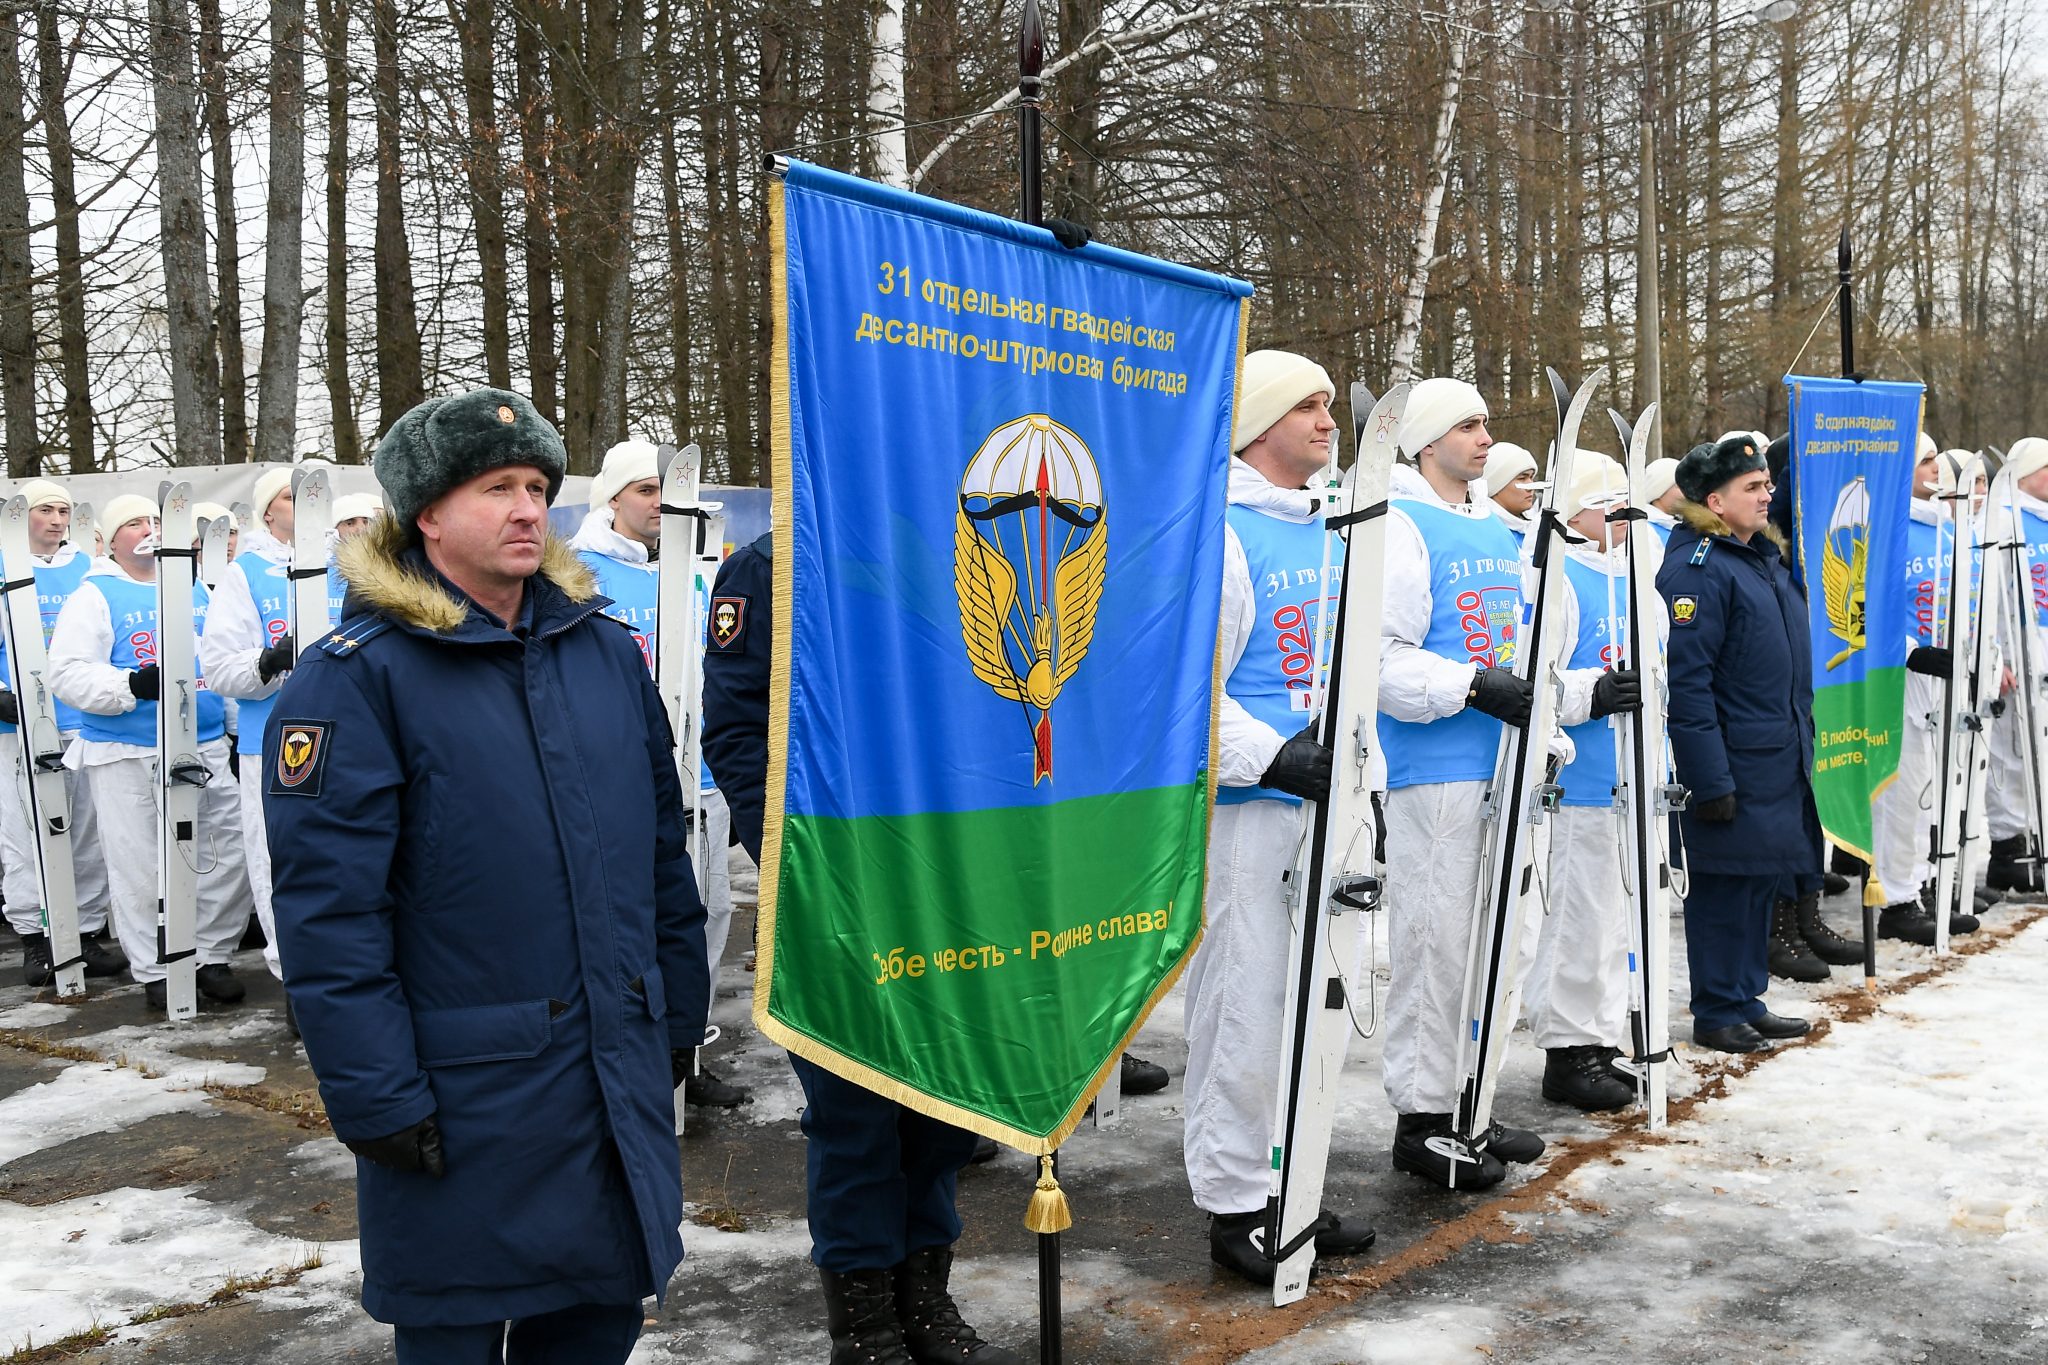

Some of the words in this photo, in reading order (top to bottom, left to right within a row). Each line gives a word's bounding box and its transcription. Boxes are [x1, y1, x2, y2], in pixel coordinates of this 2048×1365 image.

[878, 261, 911, 298] 31
[921, 277, 1046, 326] отдельная
[855, 312, 1105, 382] десантно-штурмовая
[1111, 356, 1188, 398] бригада
[2026, 542, 2037, 557] 6
[1266, 568, 1291, 598] 31
[1447, 558, 1472, 584] 31
[124, 609, 143, 629] 31
[261, 597, 281, 615] 31
[1487, 600, 1497, 611] 75
[1455, 590, 1495, 669] 2020
[1273, 605, 1315, 690] 2020
[1821, 731, 1828, 748] В
[932, 944, 1005, 974] честь
[1030, 924, 1093, 961] Родине
